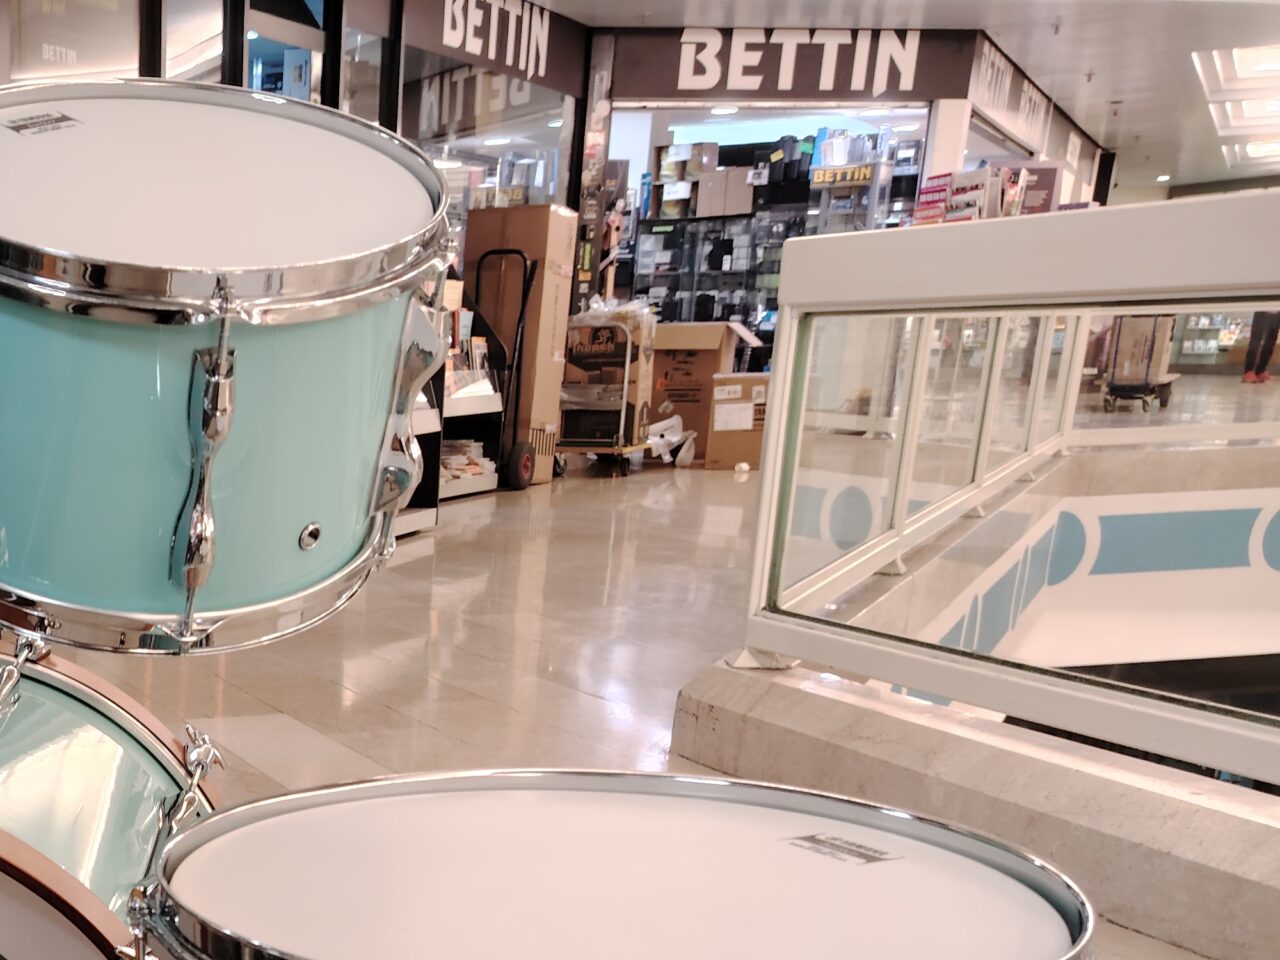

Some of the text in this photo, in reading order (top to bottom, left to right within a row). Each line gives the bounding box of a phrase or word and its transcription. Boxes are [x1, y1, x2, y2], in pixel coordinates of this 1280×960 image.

[442, 0, 551, 81] BETTIN
[677, 27, 921, 98] BETTIN
[813, 166, 872, 185] BETTIN
